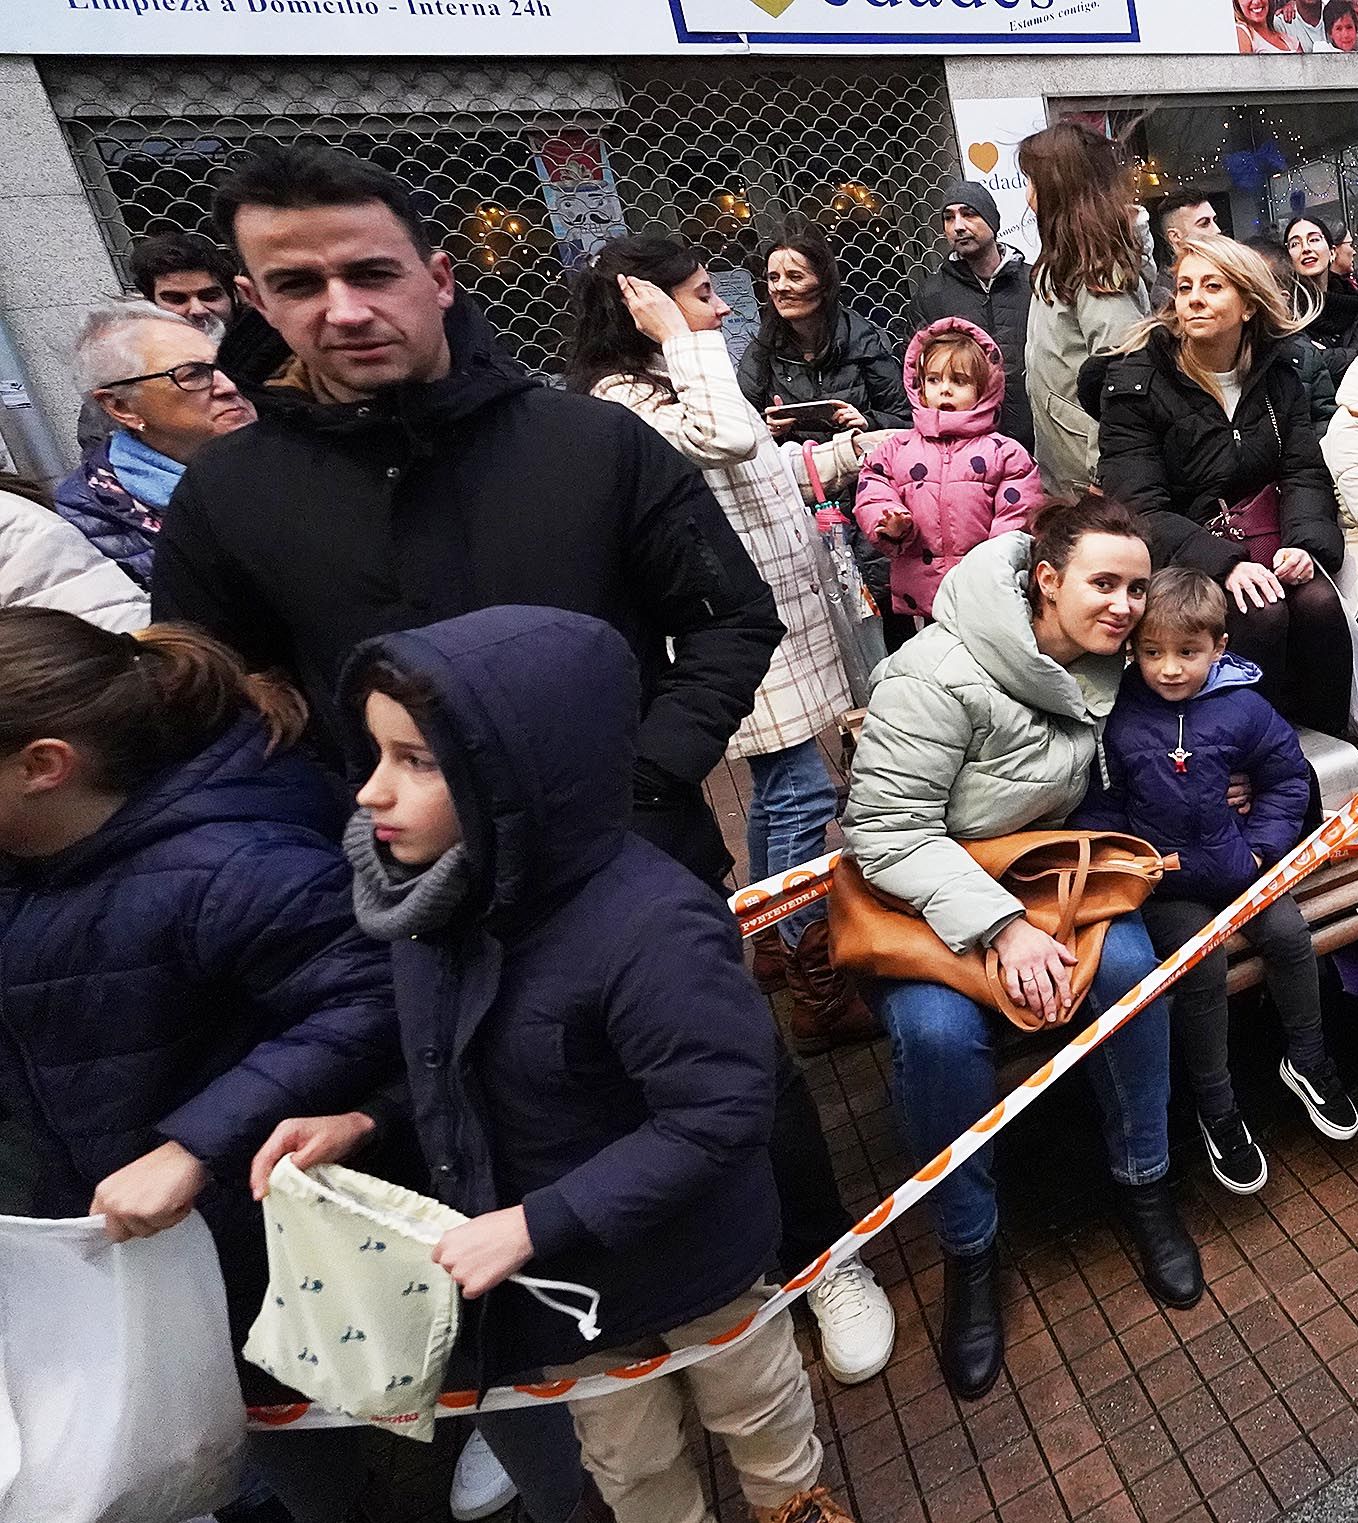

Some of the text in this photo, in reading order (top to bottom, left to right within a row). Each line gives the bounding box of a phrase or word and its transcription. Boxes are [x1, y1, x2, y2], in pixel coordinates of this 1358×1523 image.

[249, 0, 379, 14] Domicilio
[408, 0, 501, 16] Interna
[511, 0, 551, 17] 24h
[1009, 12, 1055, 32] Estamos
